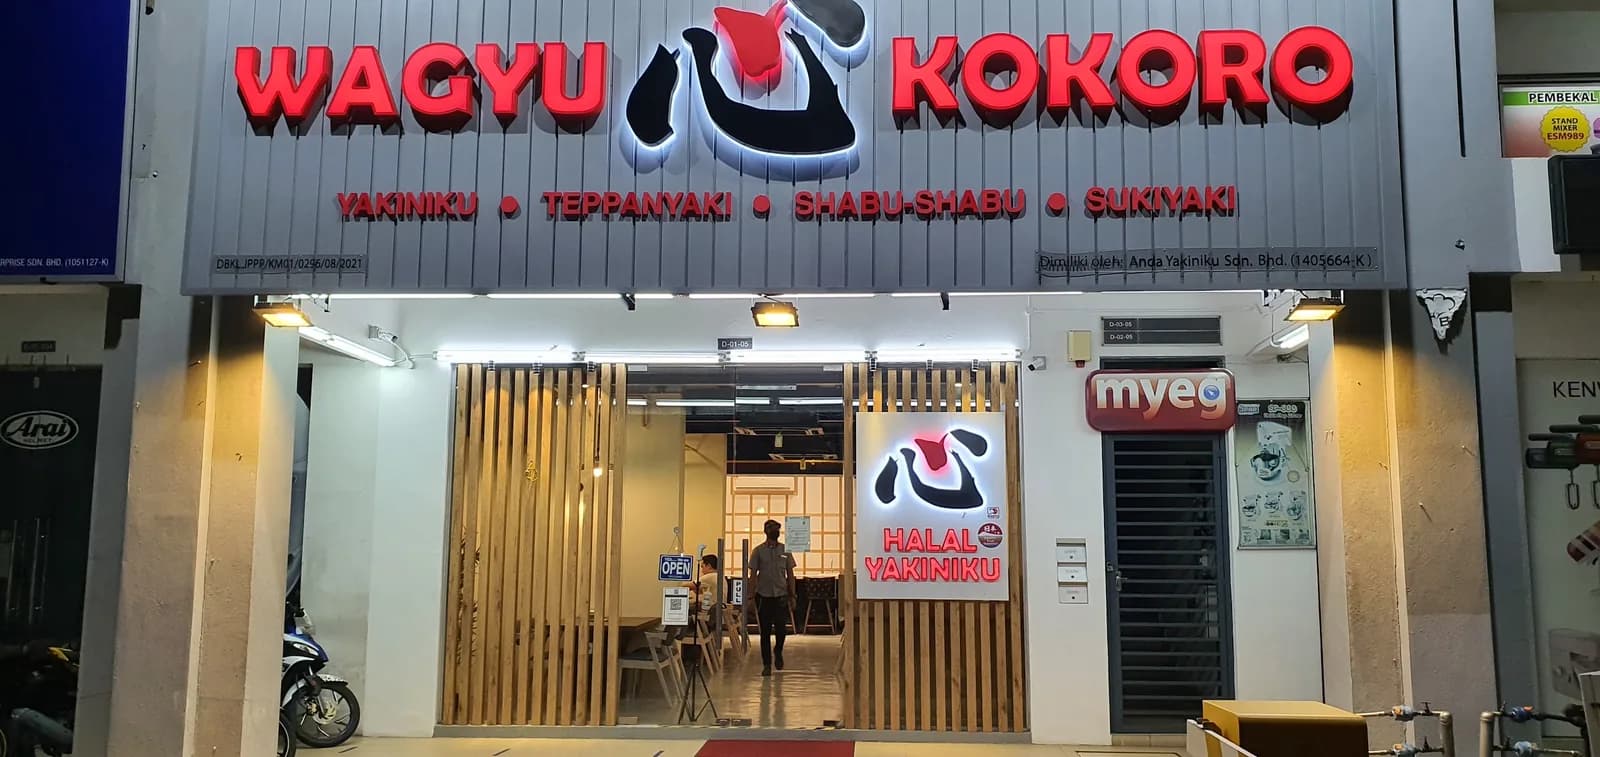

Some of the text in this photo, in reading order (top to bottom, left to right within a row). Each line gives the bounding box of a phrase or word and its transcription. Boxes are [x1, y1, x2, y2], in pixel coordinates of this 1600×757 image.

[235, 25, 1355, 127] WAGYU KOKORO
[1528, 92, 1598, 103] PEMBEKAL
[1551, 117, 1578, 125] STAND
[1546, 132, 1585, 141] ESM989
[337, 184, 1237, 219] YAKINIKU TEPPANYAKI SHABU-SHABU SUKIYAKI
[1129, 255, 1163, 268] Anda
[1165, 254, 1220, 268] Yakiniku
[1224, 253, 1253, 268] Sdn.
[1258, 253, 1287, 267] Bhd.
[1096, 375, 1228, 420] myeg
[7, 416, 69, 438] Arai
[883, 527, 978, 553] HALAL
[662, 561, 691, 576] OPEN
[864, 556, 1001, 582] YAKINIKU
[735, 581, 743, 604] PULL
